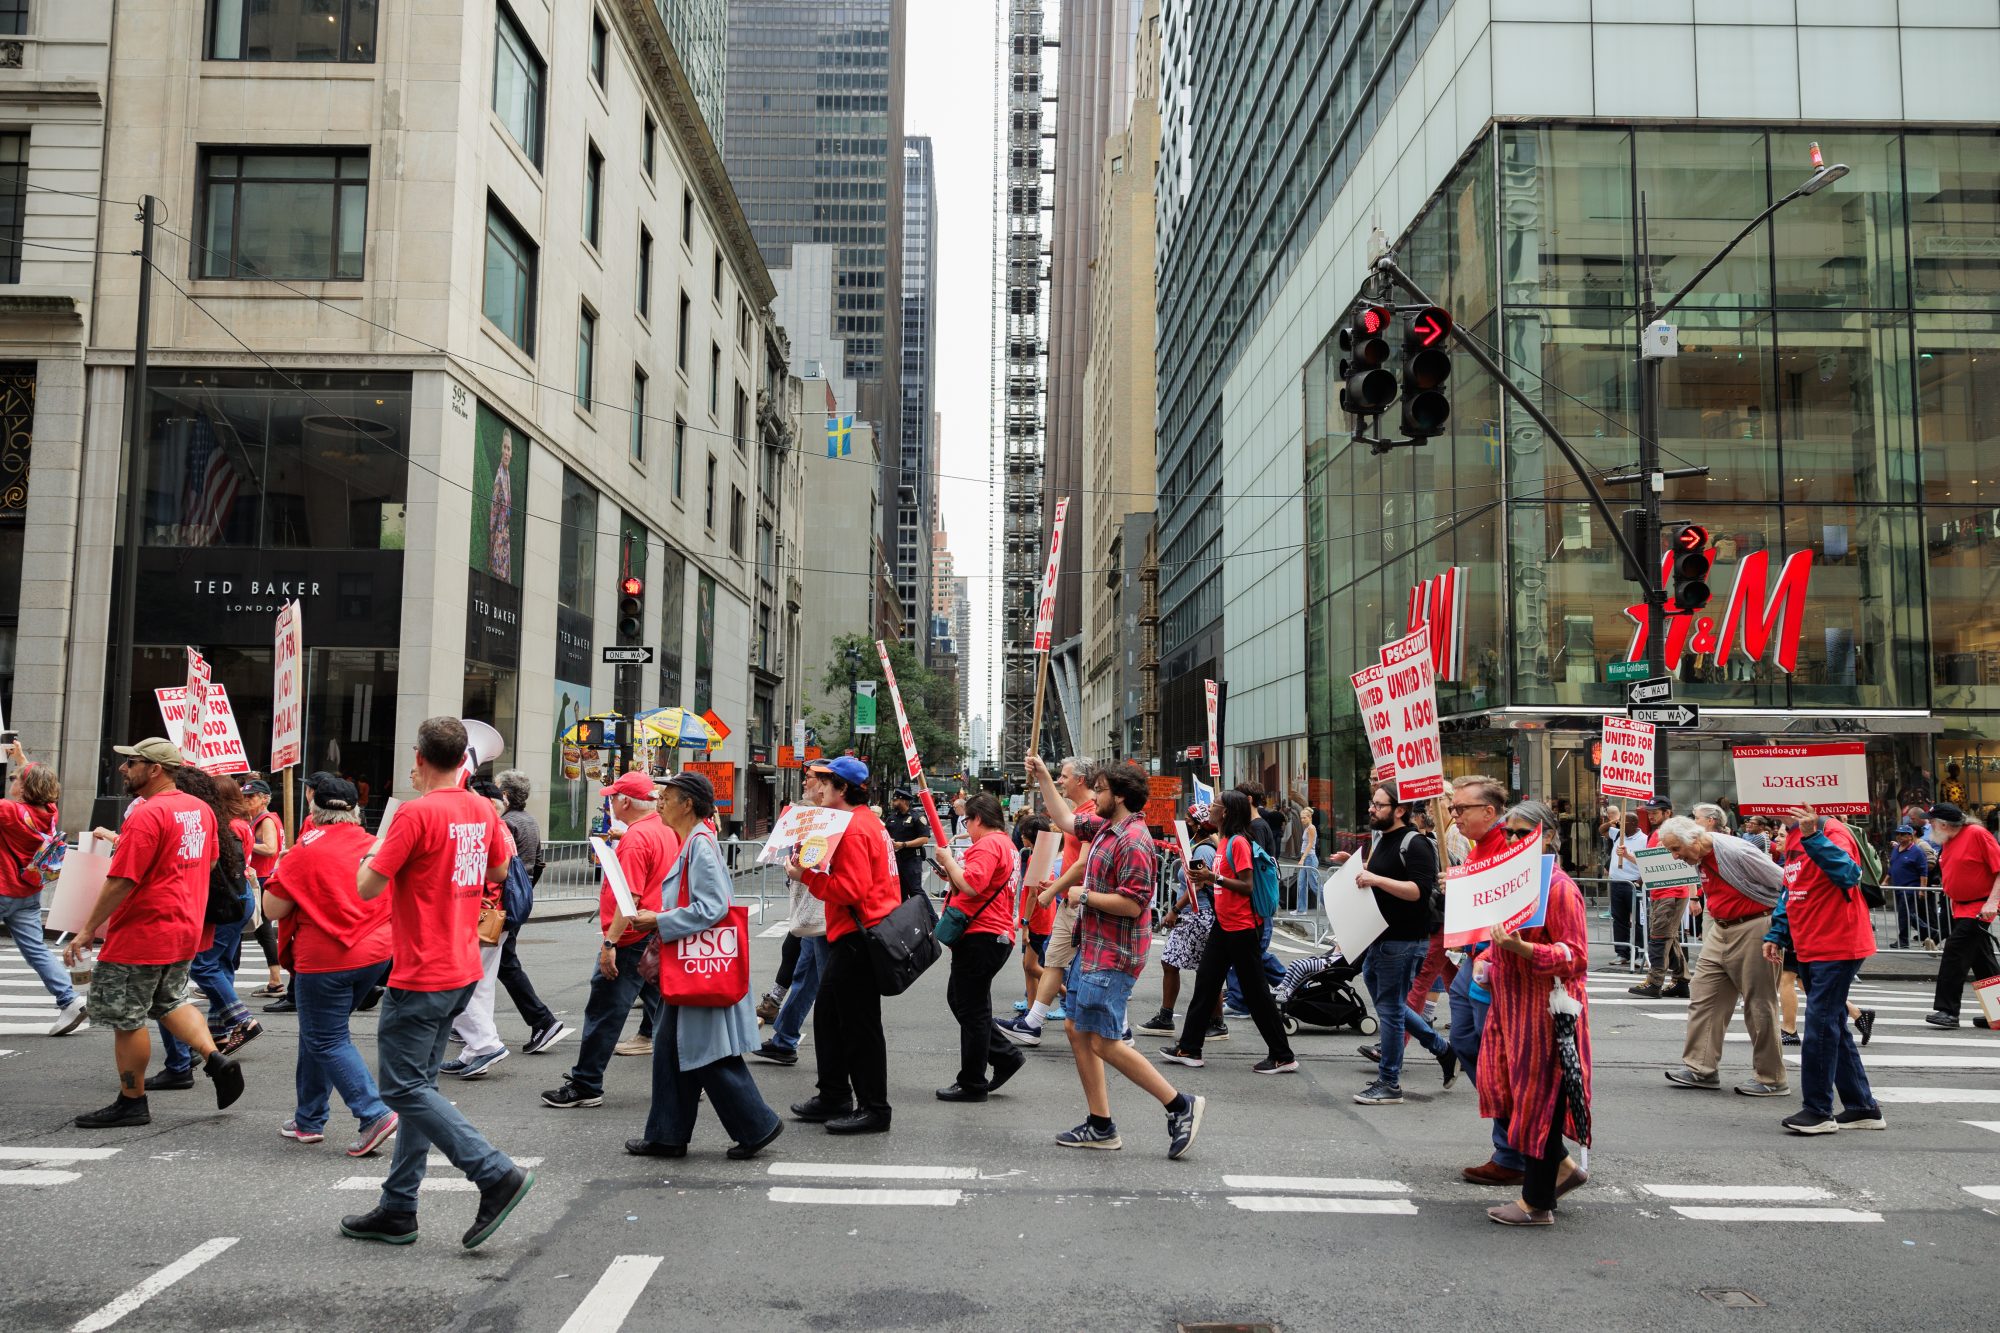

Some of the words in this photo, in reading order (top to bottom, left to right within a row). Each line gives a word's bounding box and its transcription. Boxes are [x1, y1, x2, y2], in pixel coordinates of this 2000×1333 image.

[453, 384, 466, 406] 595
[194, 580, 232, 594] TED
[251, 582, 320, 595] BAKER
[226, 604, 284, 612] LONDON
[475, 600, 489, 616] TED
[493, 606, 516, 624] BAKER
[1624, 547, 1813, 673] H&M
[560, 631, 571, 644] TED
[573, 636, 590, 650] BAKER
[1387, 632, 1426, 665] PSC-CUNY
[609, 651, 625, 659] ONE
[630, 651, 646, 659] WAY
[1609, 663, 1626, 673] William
[1627, 662, 1649, 674] Goldberg
[1356, 670, 1383, 687] PSC-CU
[1359, 686, 1383, 712] UNITED
[1635, 687, 1646, 699] ONE
[1651, 685, 1665, 696] WAY
[209, 700, 230, 715] FOR
[1638, 711, 1658, 720] ONE
[1667, 711, 1688, 720] WAY
[202, 720, 227, 738] OOD
[1404, 707, 1412, 733] A
[1608, 719, 1652, 733] PSC-CUNY
[200, 739, 242, 760] NTRACT
[1371, 736, 1393, 760] CONTR
[1605, 730, 1636, 748] UNITED
[1638, 736, 1653, 751] FOR
[1611, 749, 1618, 762] A
[1621, 751, 1645, 766] GOOD
[1735, 747, 1808, 757] #APeoplesCUNY
[1603, 765, 1653, 785] CONTRACT
[1762, 774, 1839, 788] RESPECT
[1752, 805, 1775, 814] Want
[1820, 805, 1867, 814] PSC/CUNY
[457, 836, 485, 854] LOVES
[1449, 858, 1491, 877] PSC/CUNY
[1492, 842, 1523, 864] Members
[1523, 830, 1539, 847] Want
[1645, 861, 1688, 874] SECURITY
[1472, 868, 1531, 908] RESPECT
[680, 928, 736, 957] PSC
[684, 958, 732, 973] CUNY
